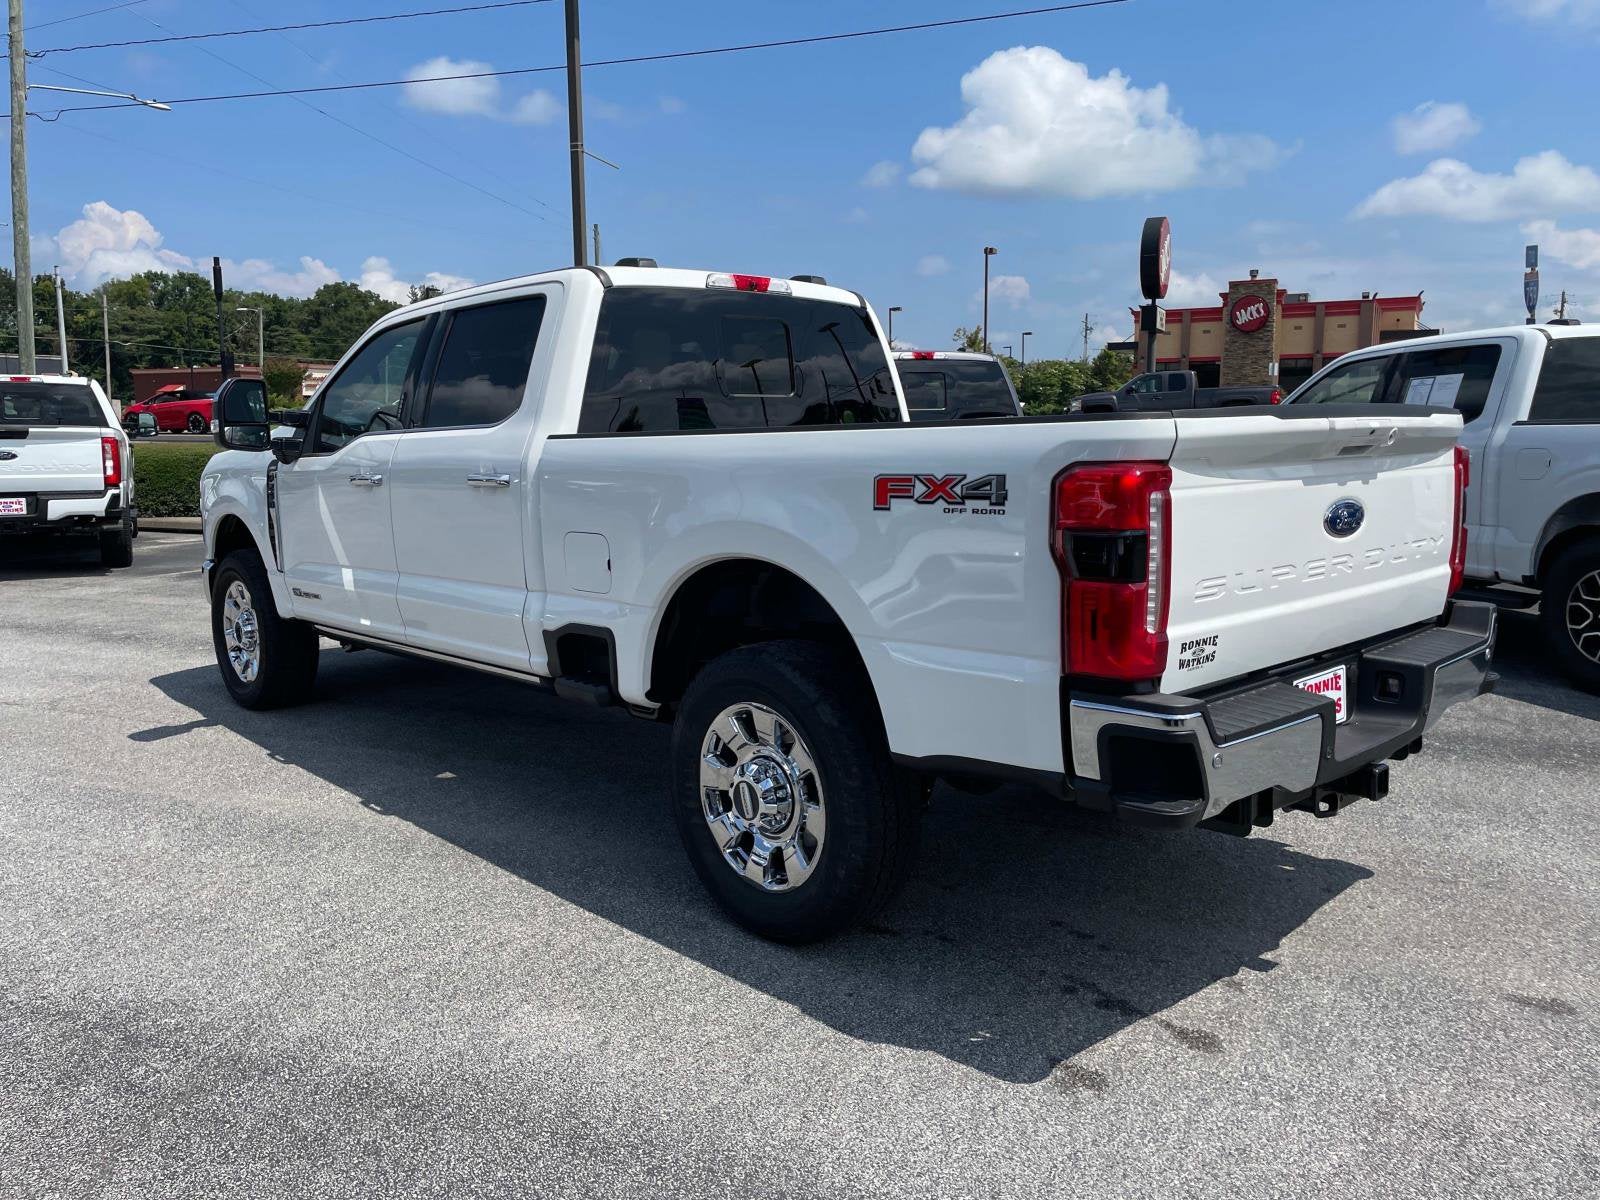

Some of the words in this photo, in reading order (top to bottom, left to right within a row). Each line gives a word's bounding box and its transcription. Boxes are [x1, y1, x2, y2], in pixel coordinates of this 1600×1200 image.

[873, 474, 1008, 511] FX4
[972, 508, 1006, 516] ROAD
[1194, 553, 1353, 603] SUPER
[1364, 534, 1444, 570] DUTY
[1180, 634, 1219, 655] RONNIE
[1178, 650, 1217, 670] WATKINS
[1306, 674, 1342, 693] ONNIE
